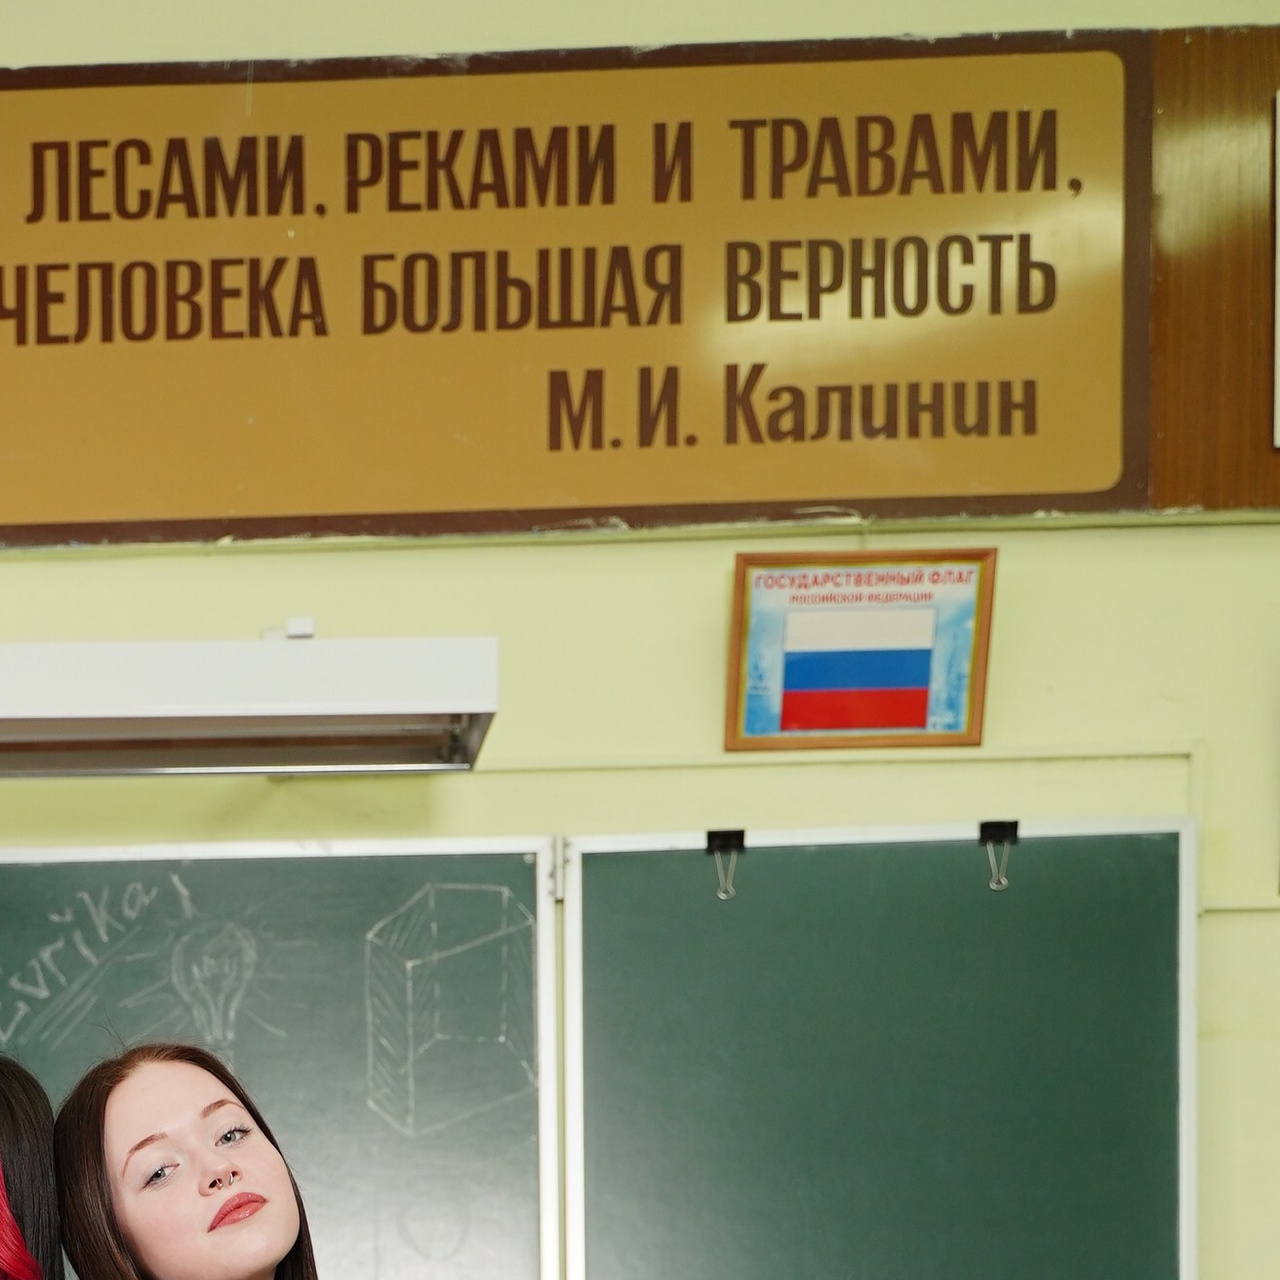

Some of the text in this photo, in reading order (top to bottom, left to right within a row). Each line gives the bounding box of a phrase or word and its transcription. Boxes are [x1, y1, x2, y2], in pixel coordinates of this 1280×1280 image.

[344, 123, 617, 215] РЕКАМИ
[652, 120, 694, 204] И
[727, 108, 1084, 202] ТРАВАМИ,
[361, 243, 684, 337] БОЛЬШАЯ
[724, 231, 1058, 325] ВЕРНОСТЬ
[723, 361, 1038, 446] Калинин
[754, 567, 975, 591] ГОСУДАРСТВЕННЫЙ ФЛАГ
